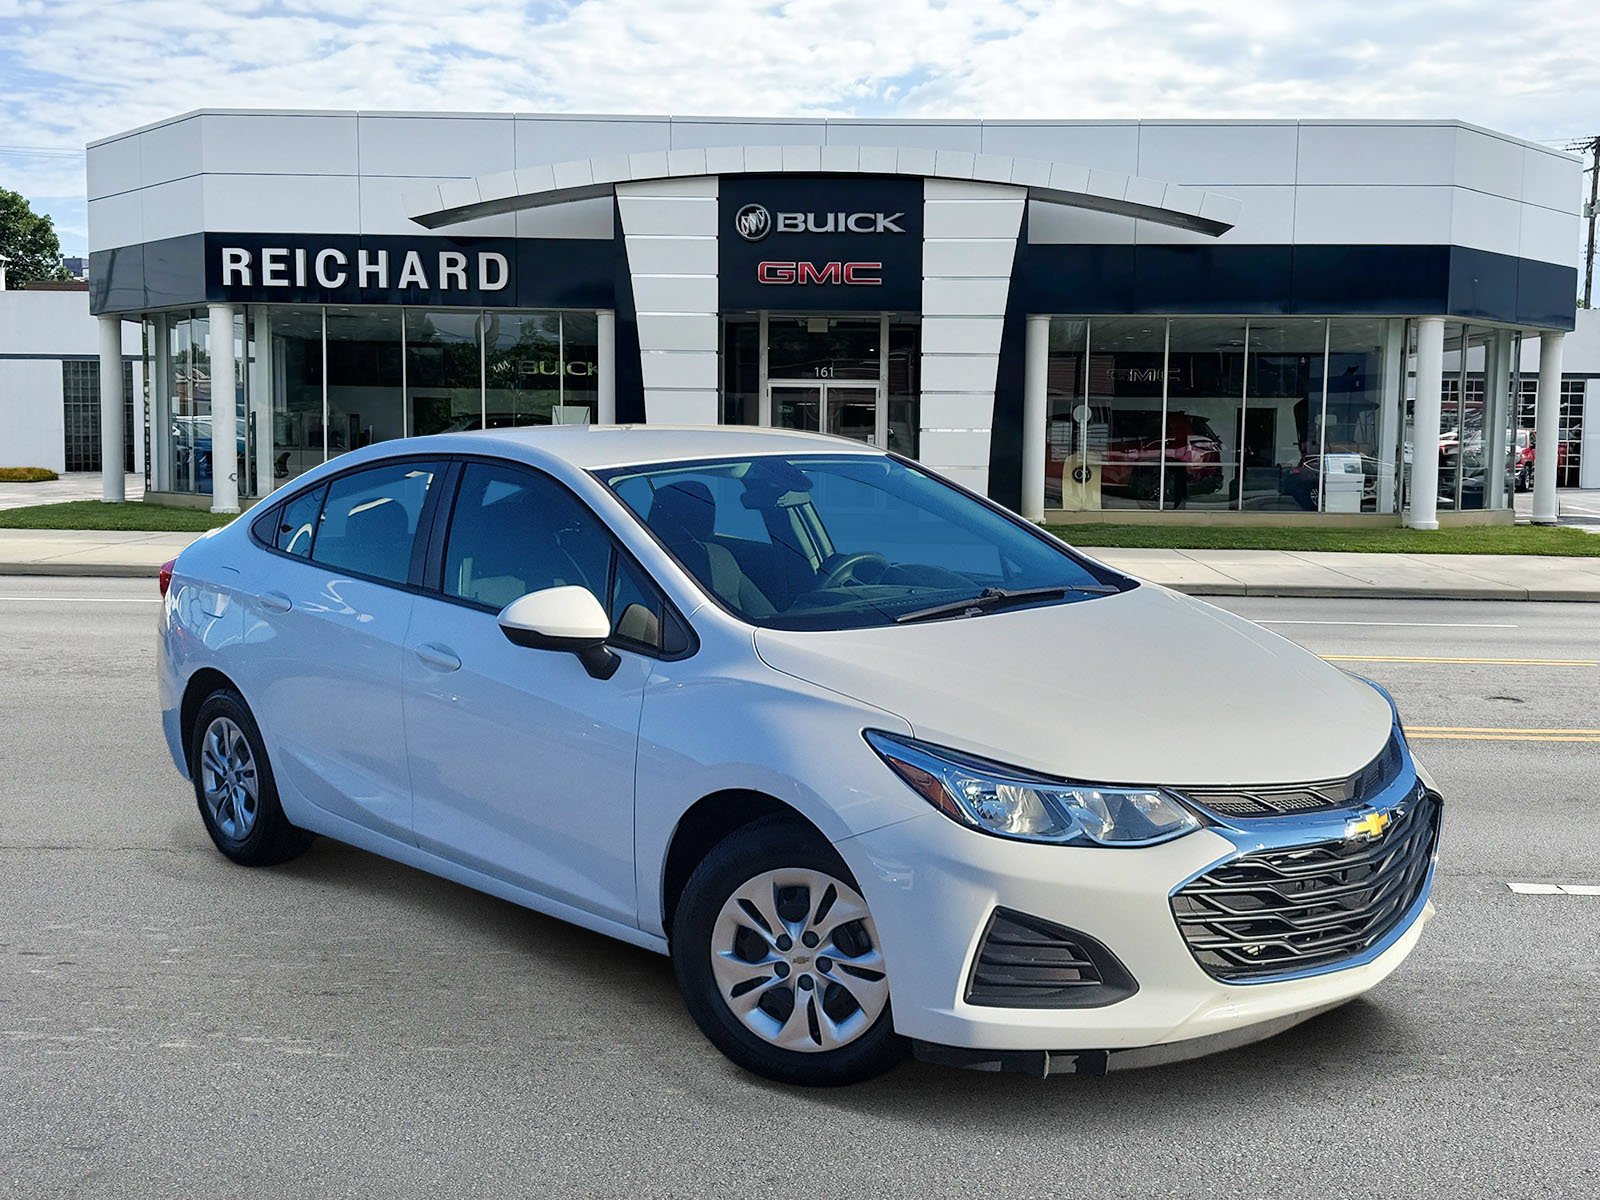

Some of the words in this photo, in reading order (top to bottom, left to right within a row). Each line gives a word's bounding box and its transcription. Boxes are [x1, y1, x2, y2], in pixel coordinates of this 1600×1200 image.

[776, 212, 906, 233] BUICK
[222, 247, 509, 291] REICHARD
[757, 261, 883, 285] GMC
[814, 366, 834, 378] 161
